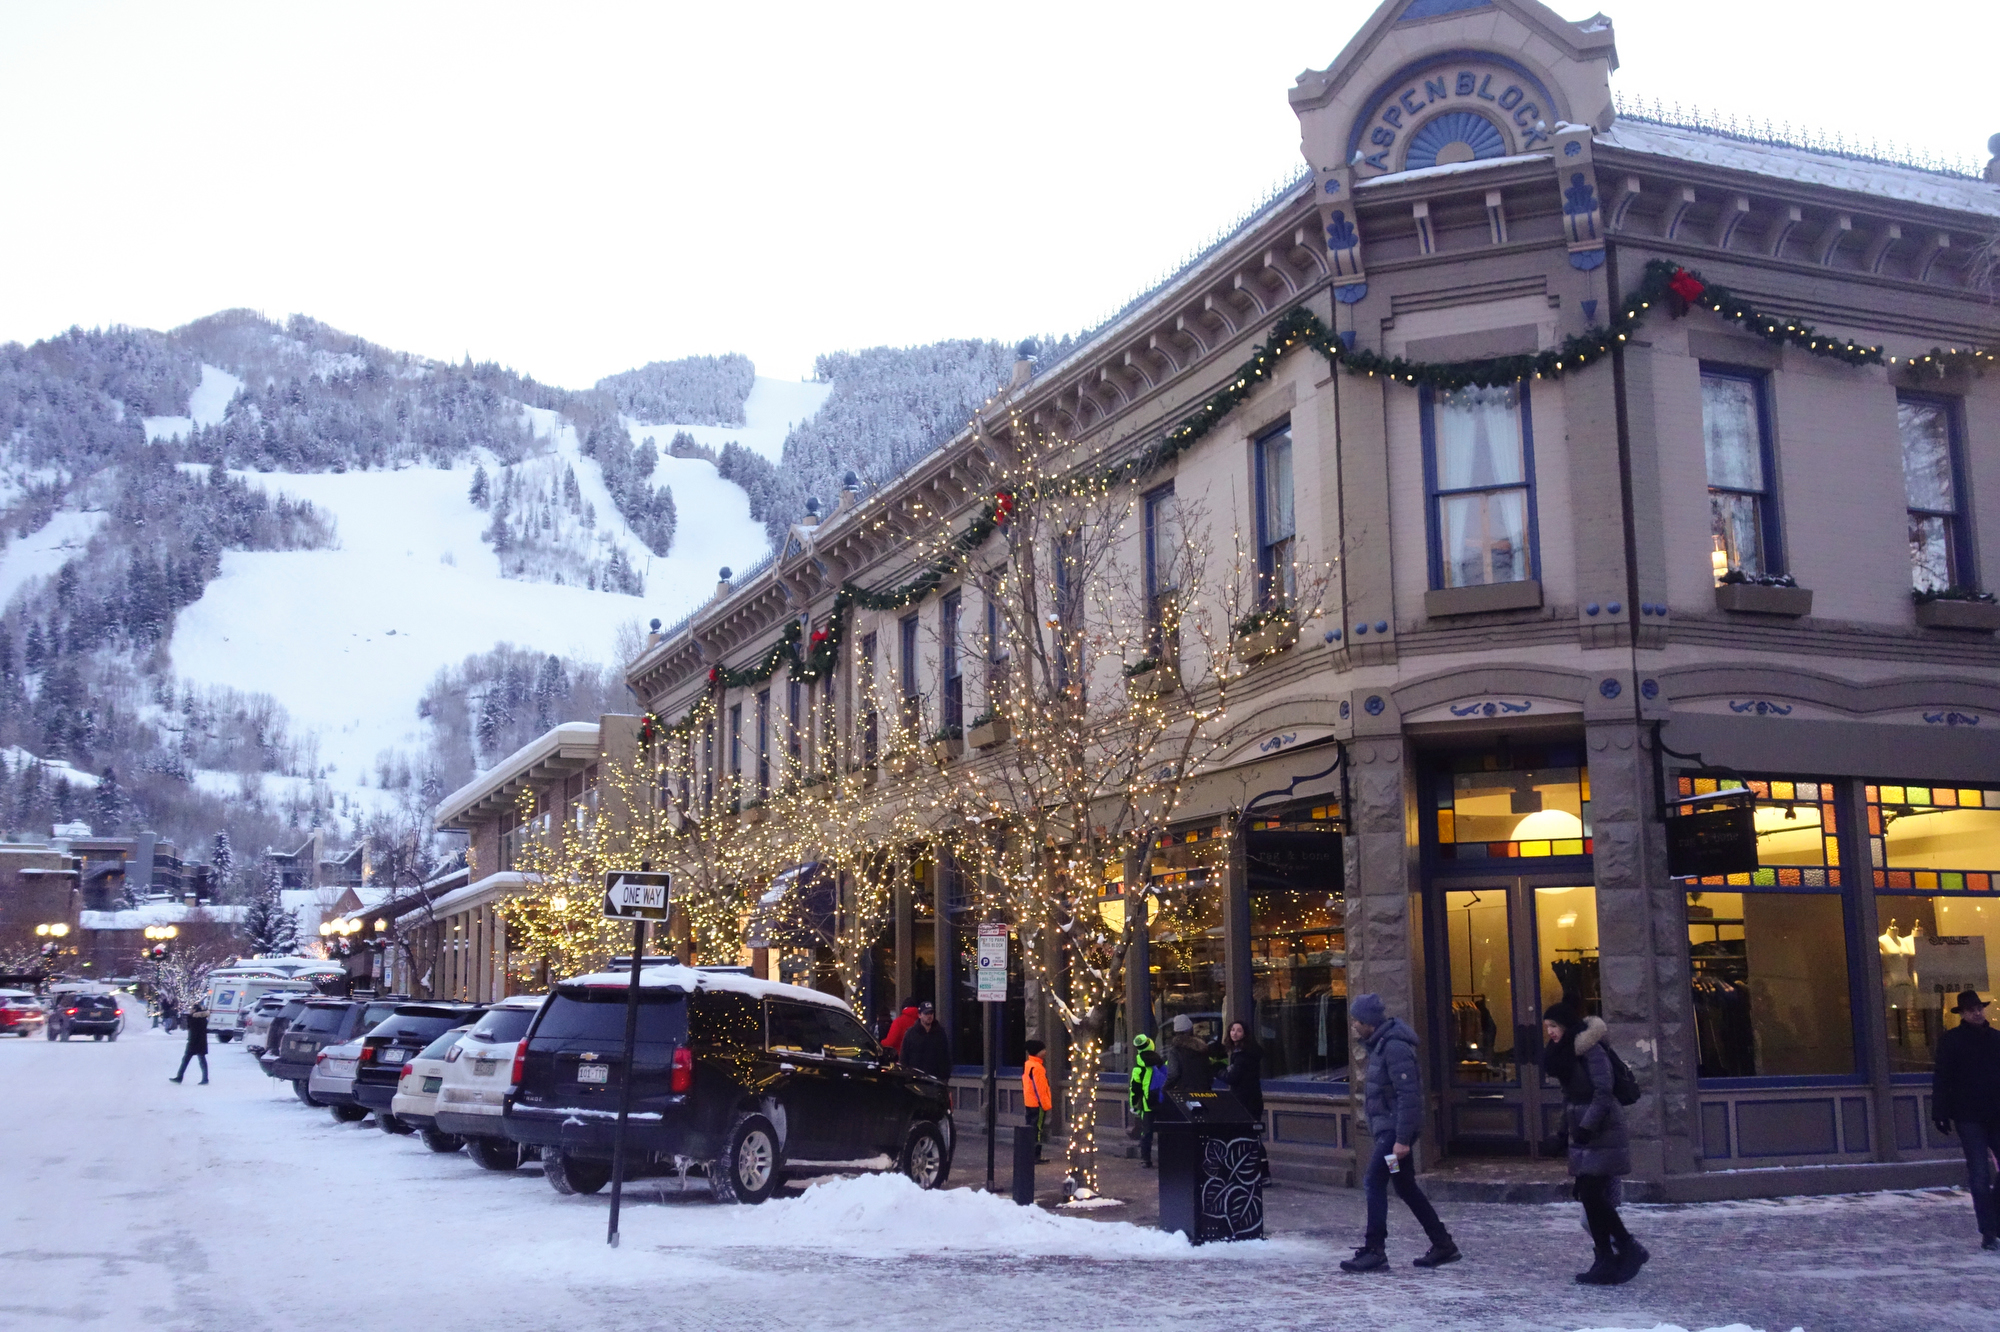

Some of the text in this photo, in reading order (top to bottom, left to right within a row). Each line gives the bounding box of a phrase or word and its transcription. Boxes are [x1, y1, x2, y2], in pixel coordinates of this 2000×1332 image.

[1365, 70, 1548, 170] ASPEN BLOCK
[1259, 850, 1330, 863] rag & bone
[623, 887, 663, 905] ONE WAY
